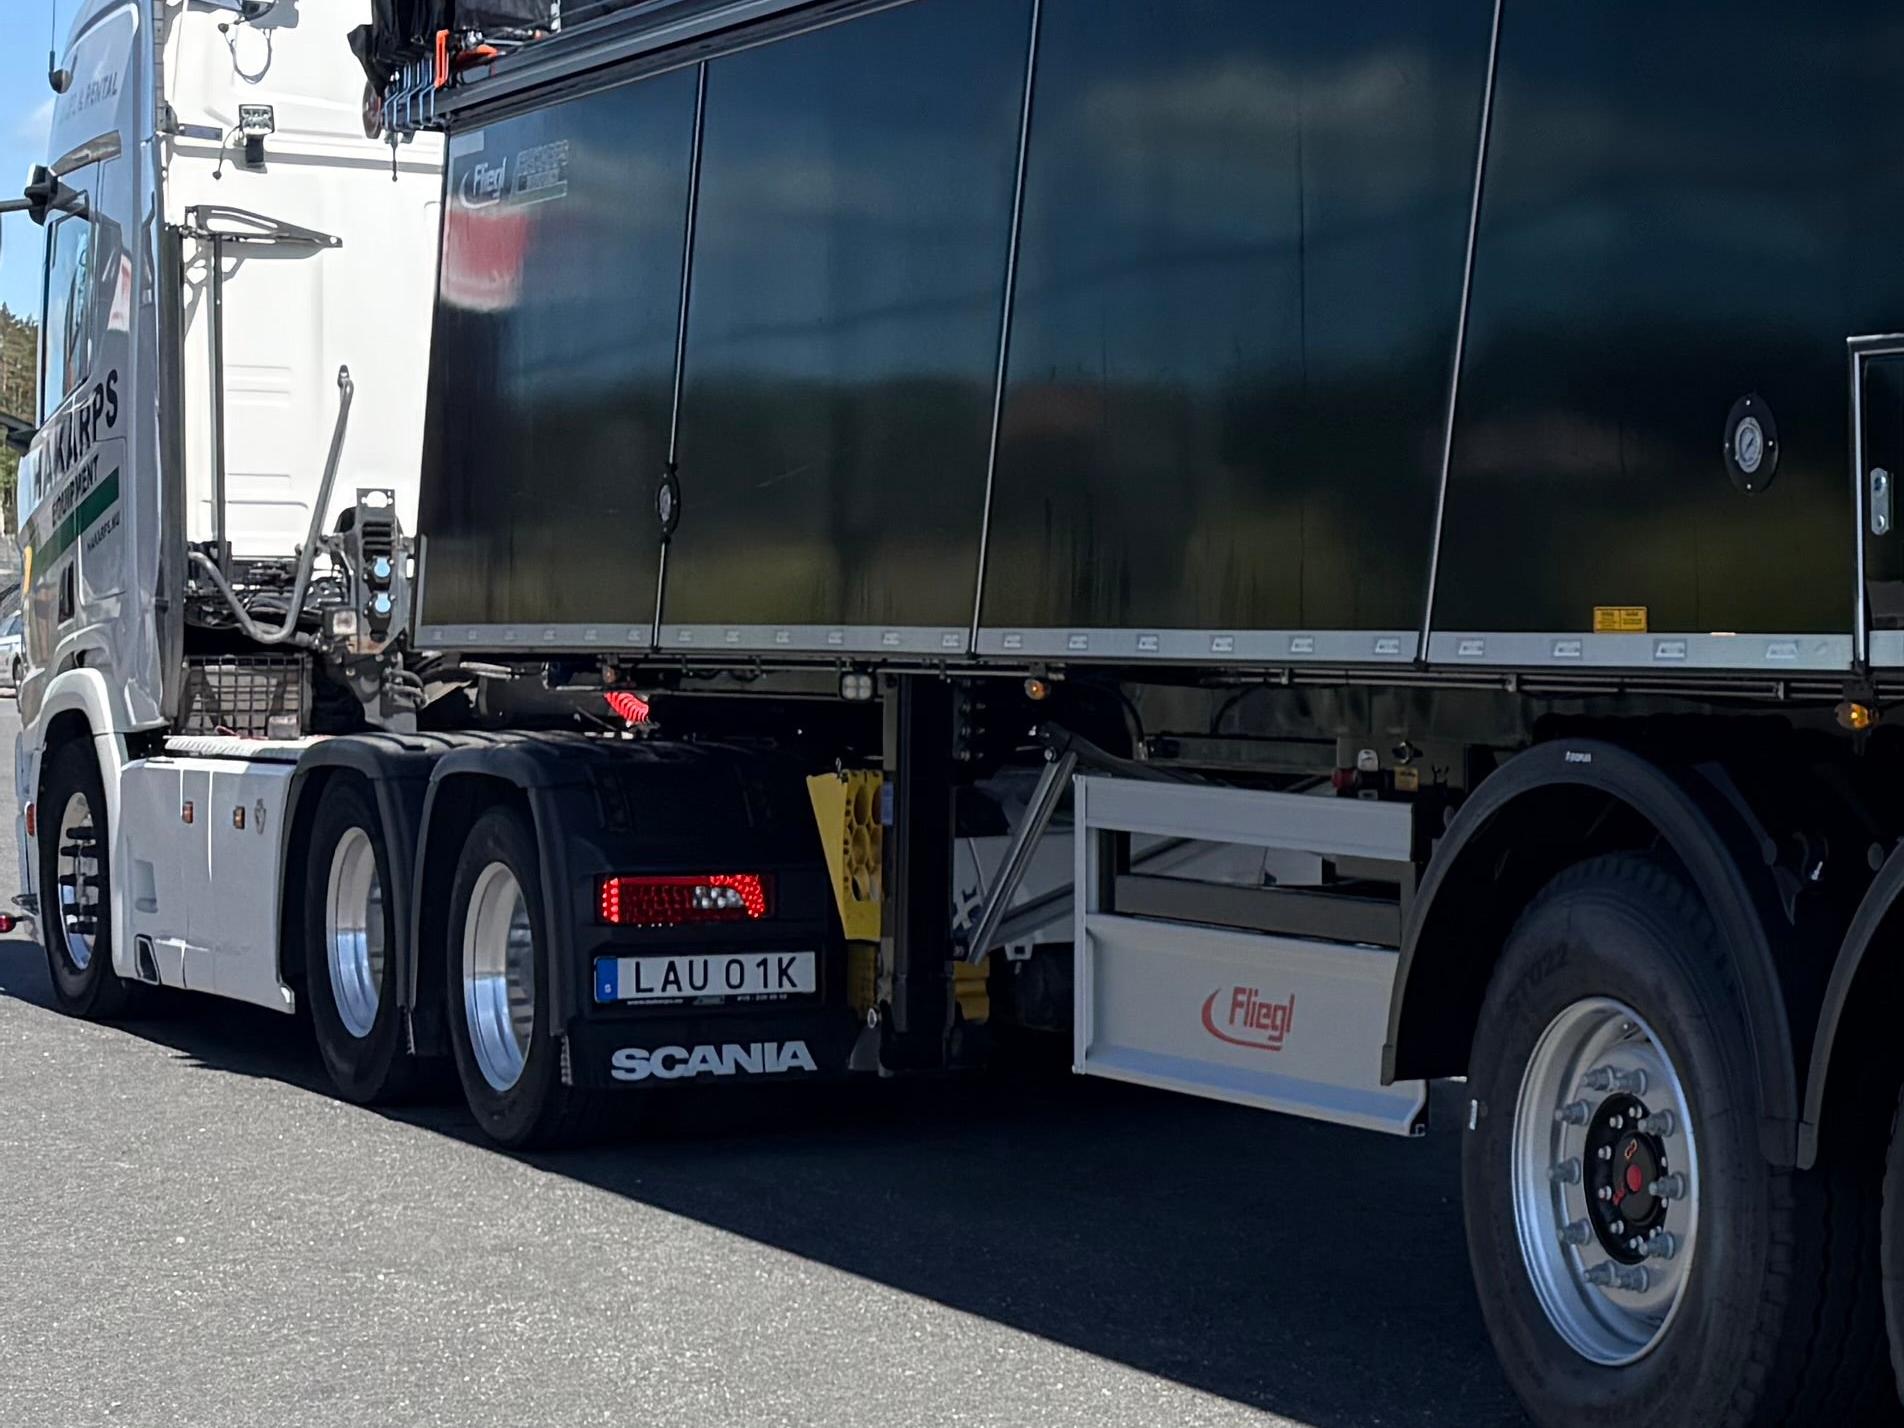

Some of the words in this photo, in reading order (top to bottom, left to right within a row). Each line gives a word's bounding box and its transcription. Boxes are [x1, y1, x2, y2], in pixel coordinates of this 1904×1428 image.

[635, 959, 708, 993] LAU
[725, 956, 798, 989] 01K
[1229, 986, 1296, 1043] Fliegl
[611, 1040, 818, 1081] SCANIA
